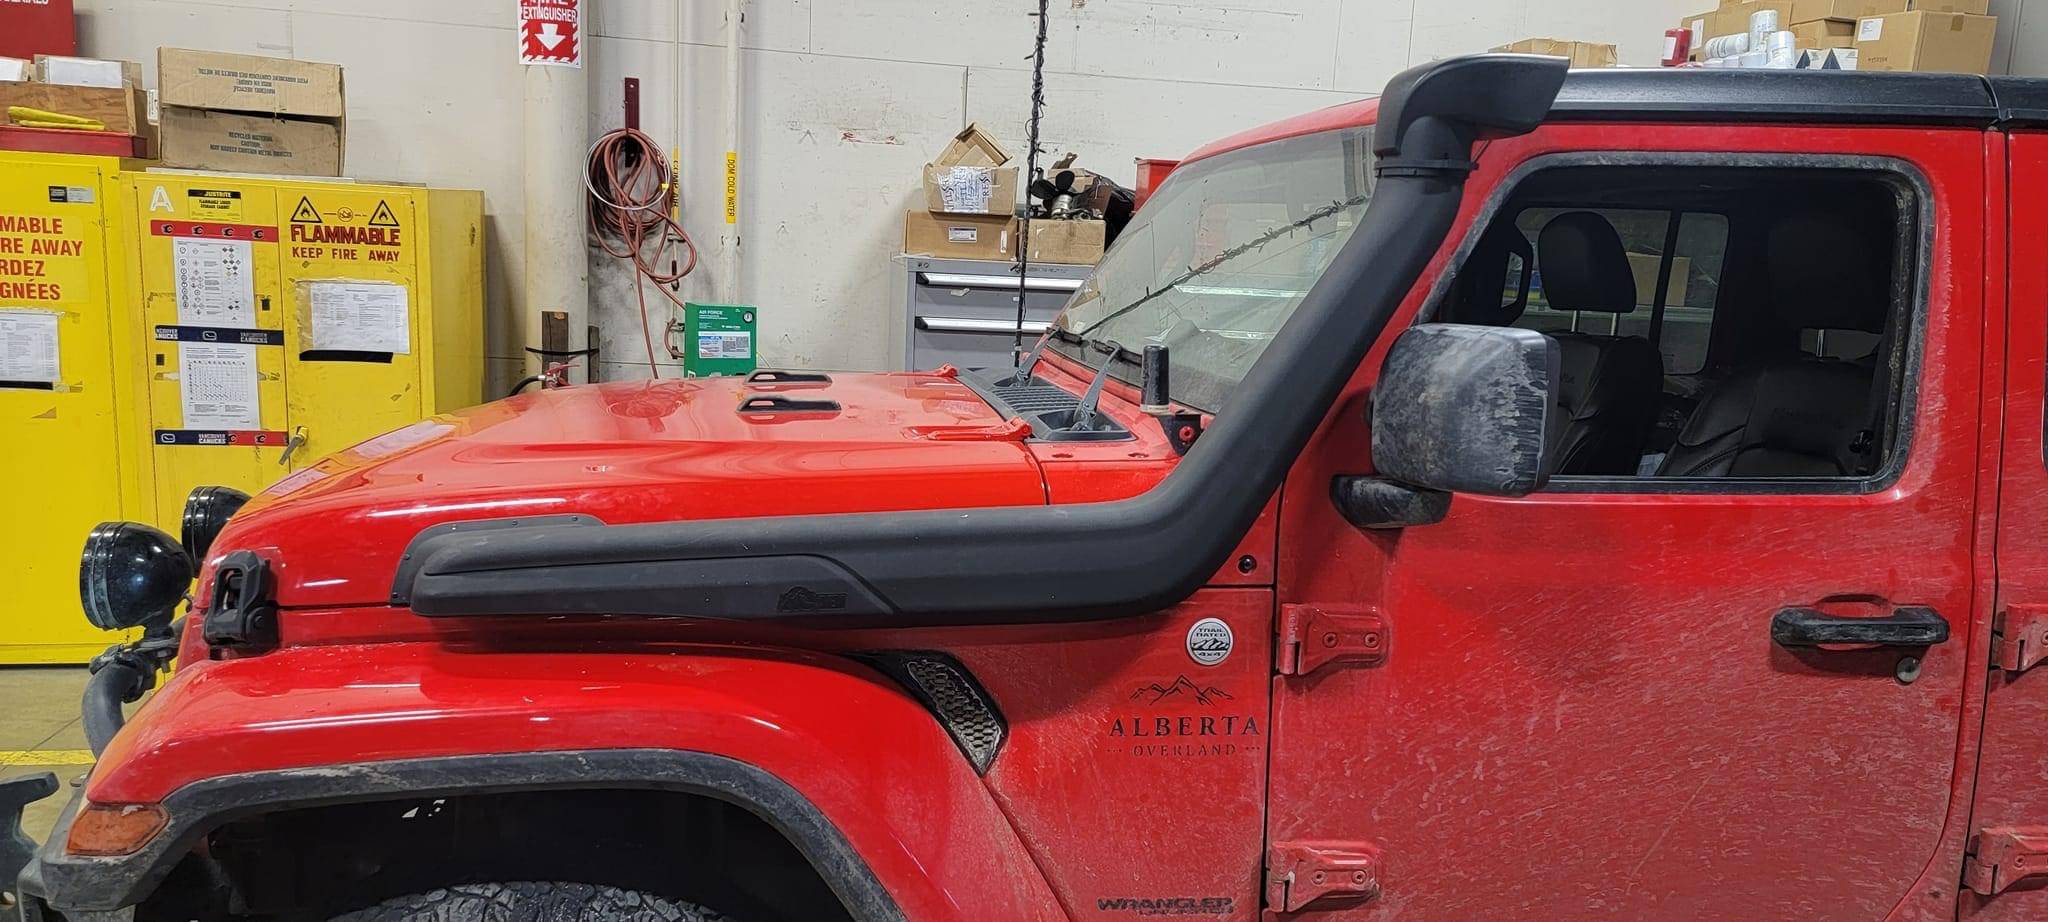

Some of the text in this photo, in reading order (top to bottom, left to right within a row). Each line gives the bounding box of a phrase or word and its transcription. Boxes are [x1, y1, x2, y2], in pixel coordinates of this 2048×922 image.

[523, 6, 577, 22] EXTINGUISHER
[728, 159, 736, 217] DOM COLD WATER
[149, 185, 175, 213] A
[0, 216, 63, 234] MABLE
[290, 224, 401, 246] FLAMMABLE
[1, 237, 83, 256] RE AWAY
[292, 246, 400, 262] KEEP FIRE AWAY
[0, 259, 45, 277] RDEZ
[0, 279, 61, 300] GNÉES
[1109, 716, 1261, 737] ALBERTA
[1133, 744, 1237, 757] OVERLAND
[1097, 897, 1233, 911] WRANGLER
